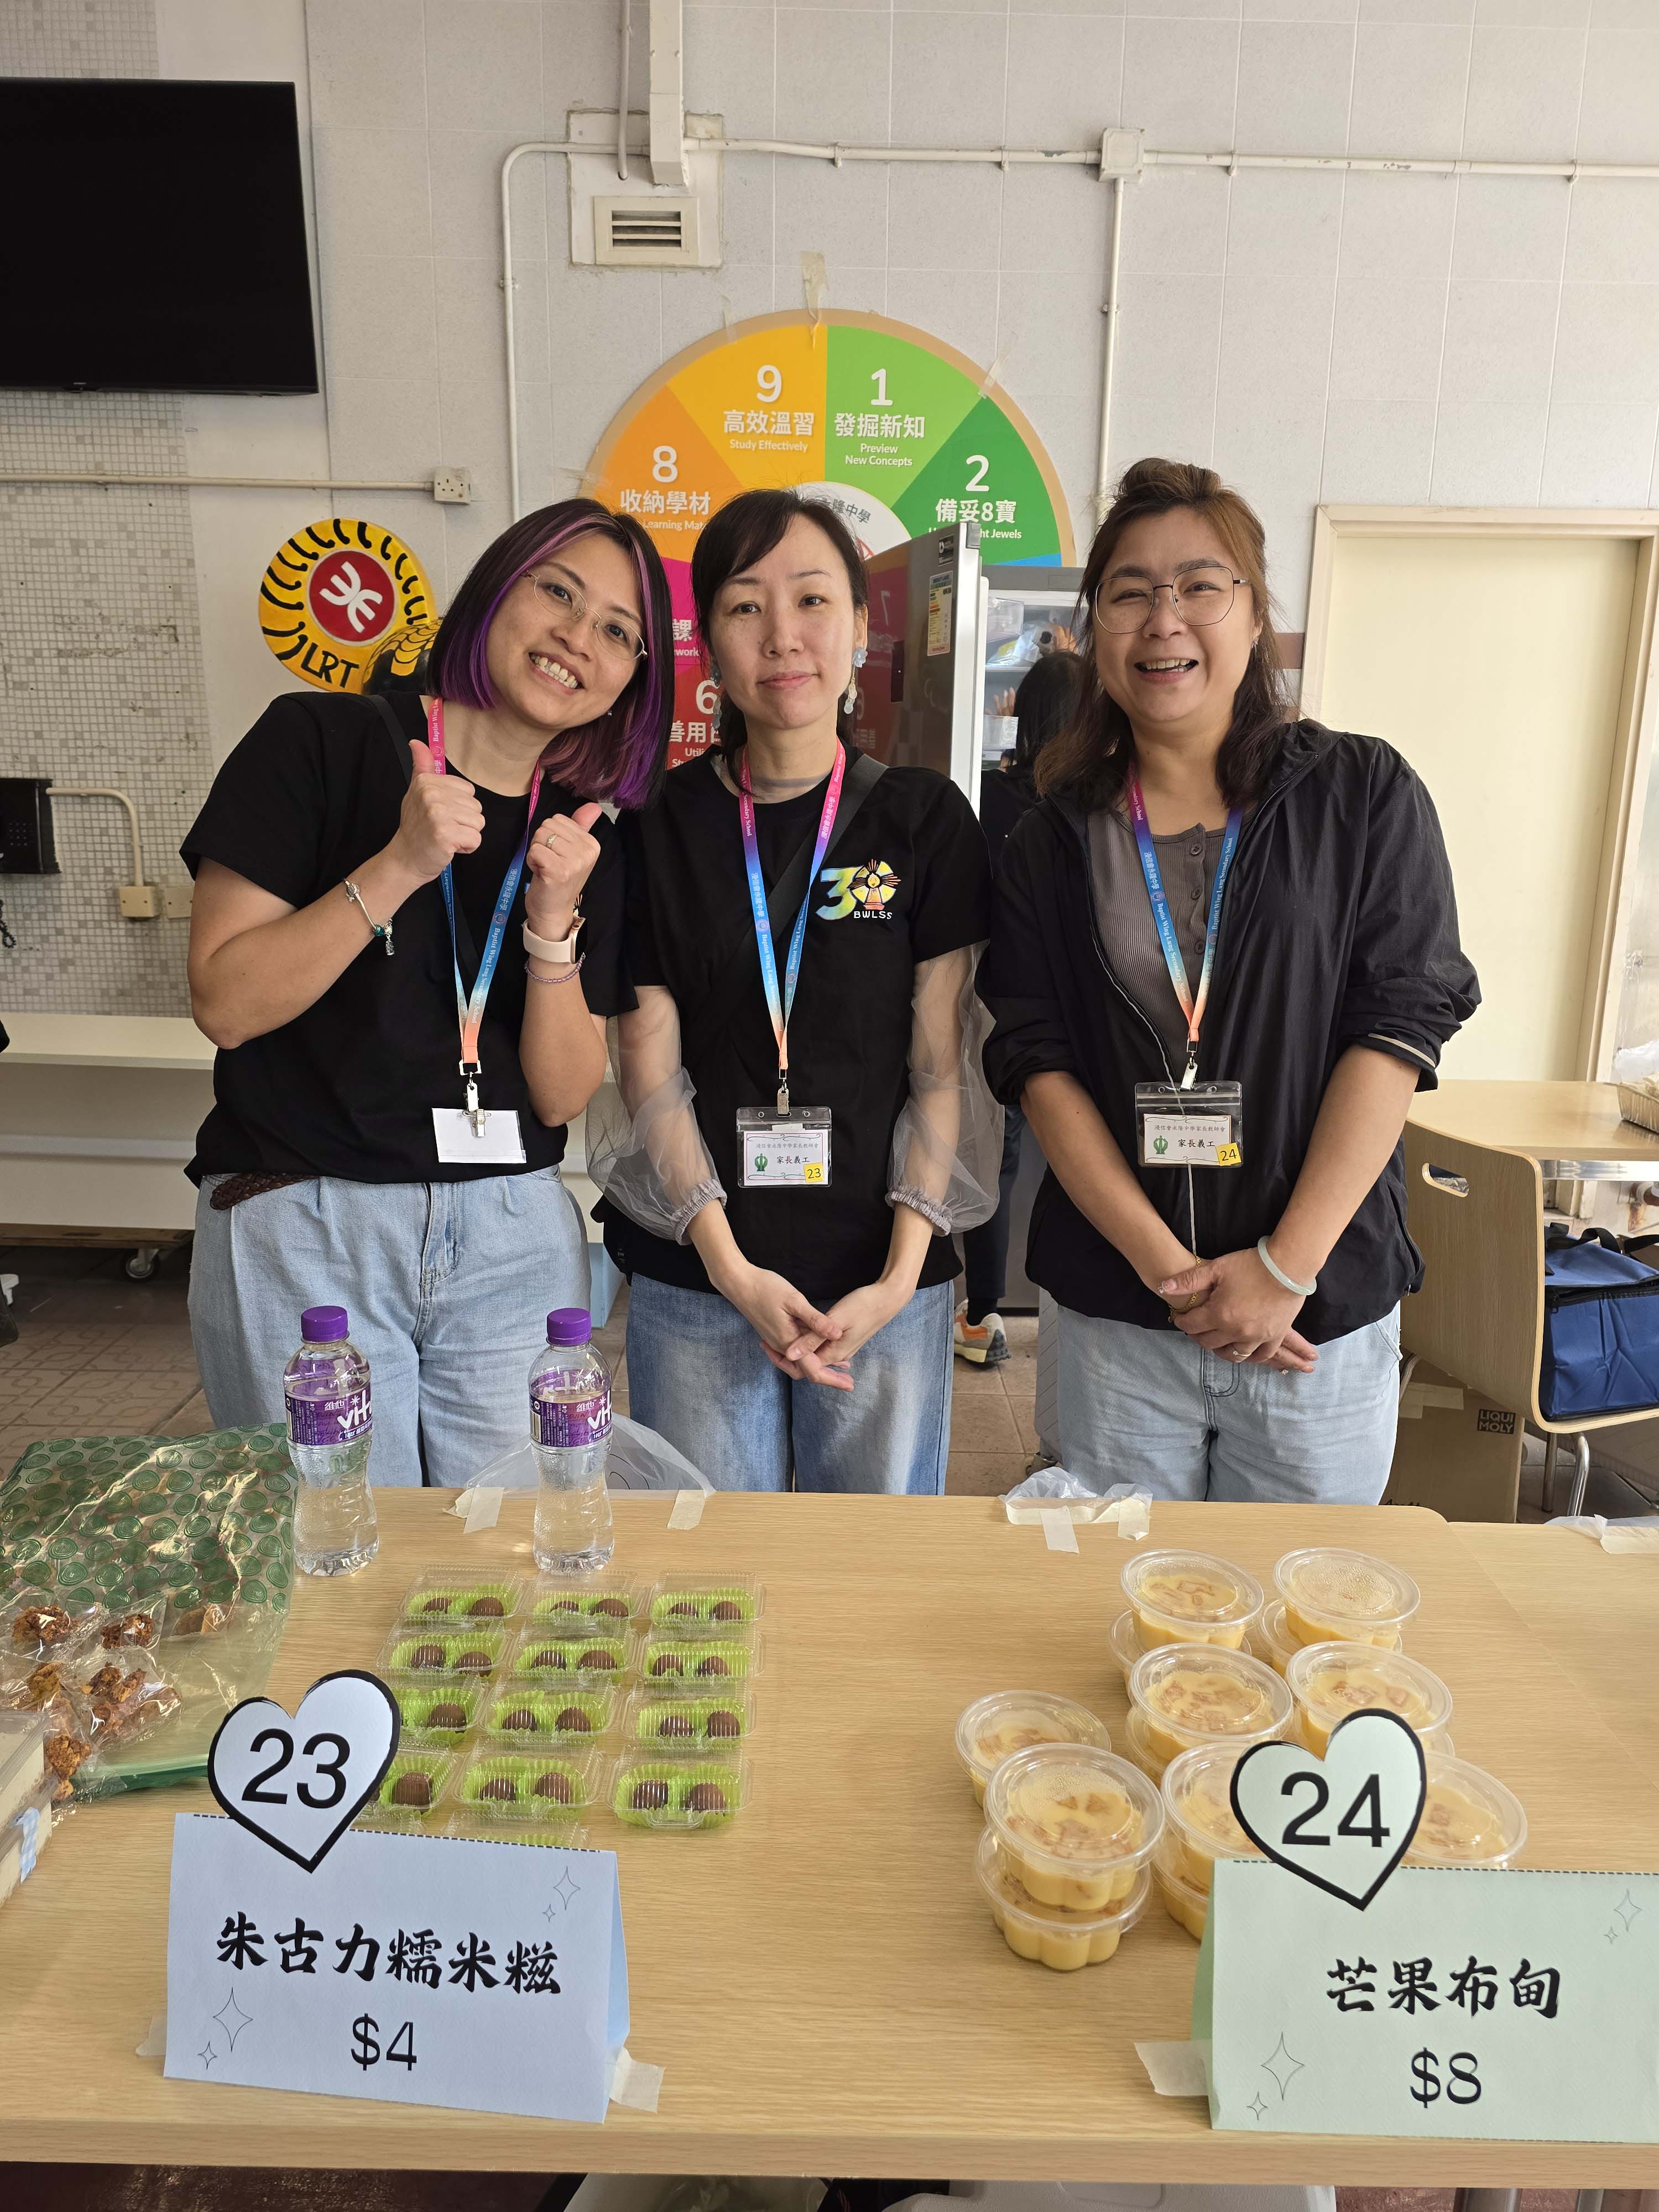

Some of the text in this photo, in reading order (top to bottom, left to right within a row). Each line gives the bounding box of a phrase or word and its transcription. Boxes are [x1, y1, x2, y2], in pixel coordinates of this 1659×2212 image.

[756, 364, 783, 403] 9
[870, 368, 894, 406] 1
[723, 409, 815, 436] 高效溫習
[834, 413, 926, 439] 發掘新知
[729, 439, 808, 452] Study Effectively
[860, 443, 898, 453] Preview
[651, 445, 679, 483] 8
[845, 455, 913, 468] New Concepts
[964, 454, 990, 492] 2
[619, 489, 711, 516] 收納學材
[935, 498, 1017, 524] 備妥8寶
[990, 529, 1022, 539] Jewels
[674, 647, 700, 656] work
[300, 642, 359, 689] LRT
[696, 679, 720, 714] 6
[1178, 1139, 1215, 1149] 家長義工
[1219, 1149, 1237, 1162] 24
[776, 1155, 810, 1164] 家長義工
[807, 1167, 822, 1179] 23
[324, 1400, 345, 1411] 維他
[576, 1400, 594, 1412] 維他
[1480, 1411, 1514, 1423] LIQUI
[1478, 1422, 1514, 1433] MOLY
[242, 1728, 351, 1809] 23
[1280, 1771, 1391, 1848] 24
[216, 1910, 561, 1995] 朱古力糯米糍
[1326, 1954, 1562, 2020] 芒果布甸
[350, 2012, 418, 2071] $4
[1409, 2047, 1483, 2109] $8
